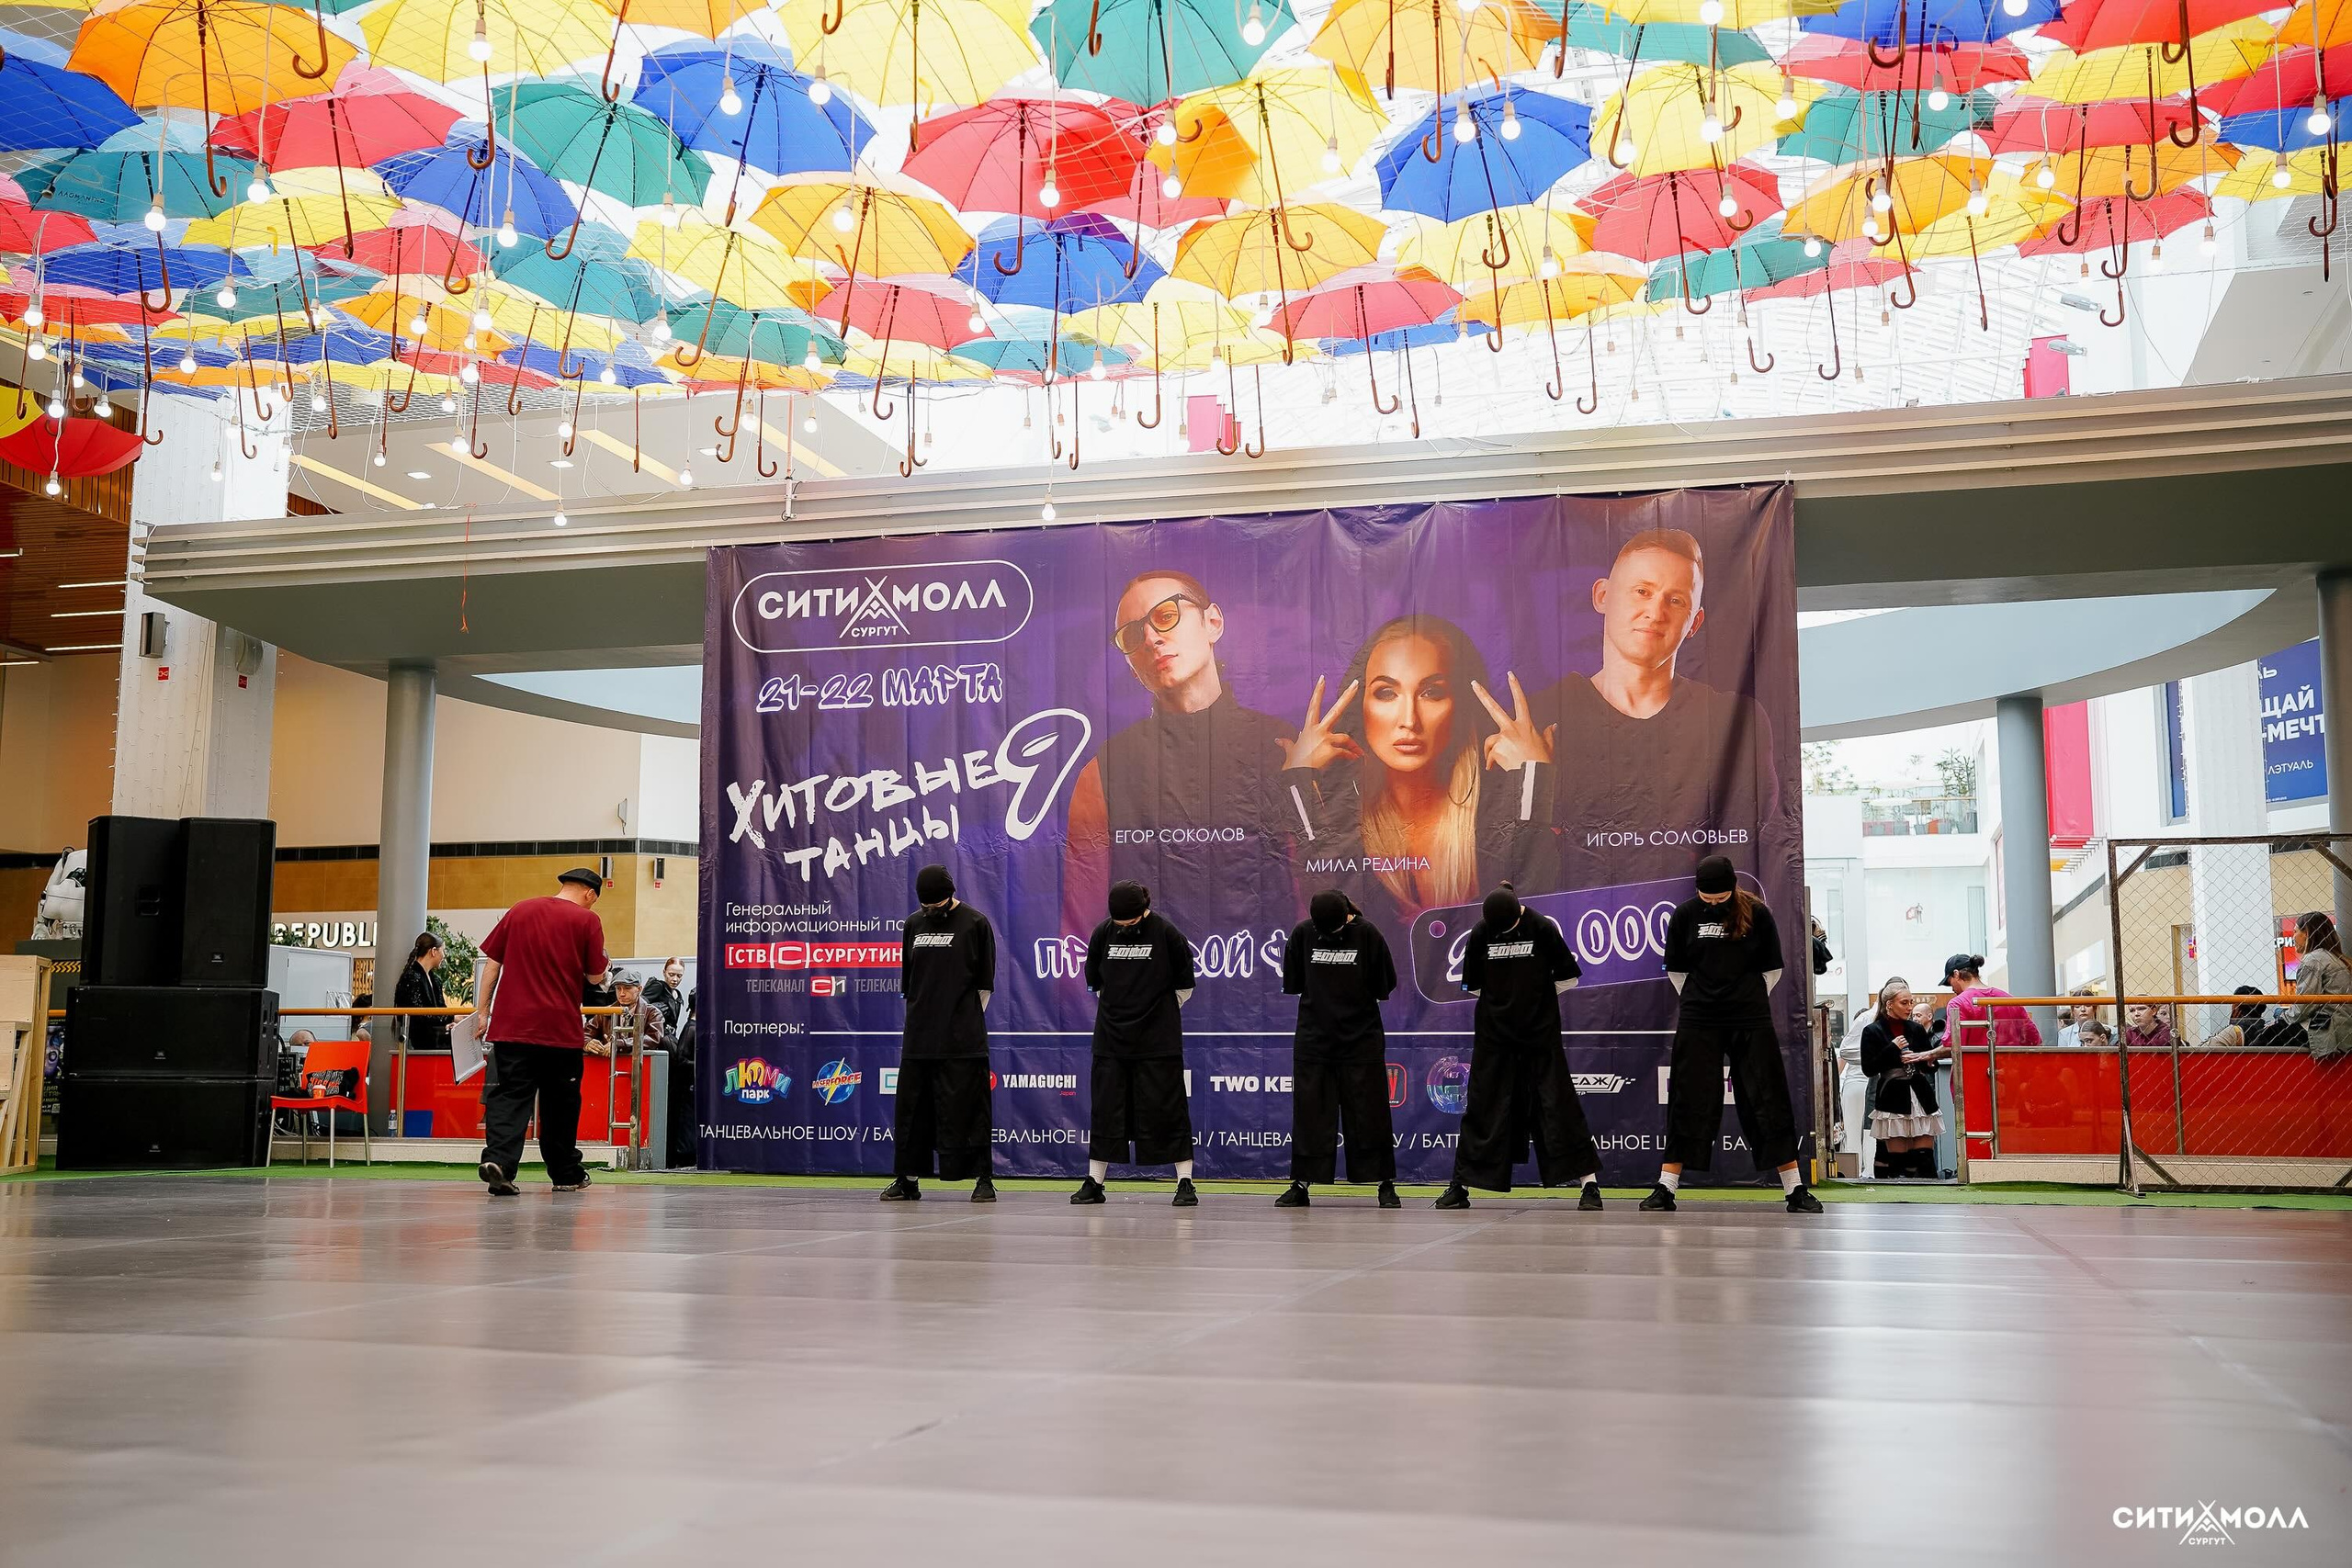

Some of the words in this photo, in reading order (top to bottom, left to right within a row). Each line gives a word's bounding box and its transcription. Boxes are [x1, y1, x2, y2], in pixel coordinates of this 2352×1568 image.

[757, 586, 858, 620] СИТИ
[893, 579, 1007, 613] МОЛЛ
[851, 626, 899, 637] СУРГУТ
[756, 673, 873, 713] 21-22
[882, 663, 1003, 706] МАРТА
[2261, 684, 2314, 718] ЩАЙ
[2262, 714, 2325, 743] -МЕЧТ
[2268, 760, 2314, 775] ЛЭТУАЛЬ
[1114, 829, 1155, 844] ЕГОР
[1159, 828, 1245, 843] СОКОЛОВ
[1587, 831, 1644, 847] ИГОРЬ
[1649, 829, 1748, 846] СОЛОВЬЕВ
[1306, 859, 1357, 873] МИЛА
[1363, 856, 1430, 872] РЕДИНА
[726, 900, 831, 919] Генеральный
[274, 922, 378, 948] REPUBLI
[726, 917, 880, 936] информационный
[812, 948, 902, 963] СУРГУТИН
[746, 979, 805, 993] ТЕЛЕКАНАЛ
[854, 979, 901, 992] ТЕЛЕКАН
[724, 1020, 805, 1037] Партнеры:
[1002, 1075, 1076, 1089] YAMAGUCHI
[1210, 1076, 1260, 1092] TWO
[1264, 1077, 1294, 1092] KE
[741, 1089, 770, 1100] парк
[699, 1124, 815, 1140] ТАНЦЕВАЛЬНОЕ
[819, 1126, 858, 1141] ШОУ
[991, 1128, 1076, 1144] ЕВАЛЬНОЕ
[1219, 1131, 1293, 1147] ТАНЦЕВА
[1422, 1134, 1461, 1148] БАТТ
